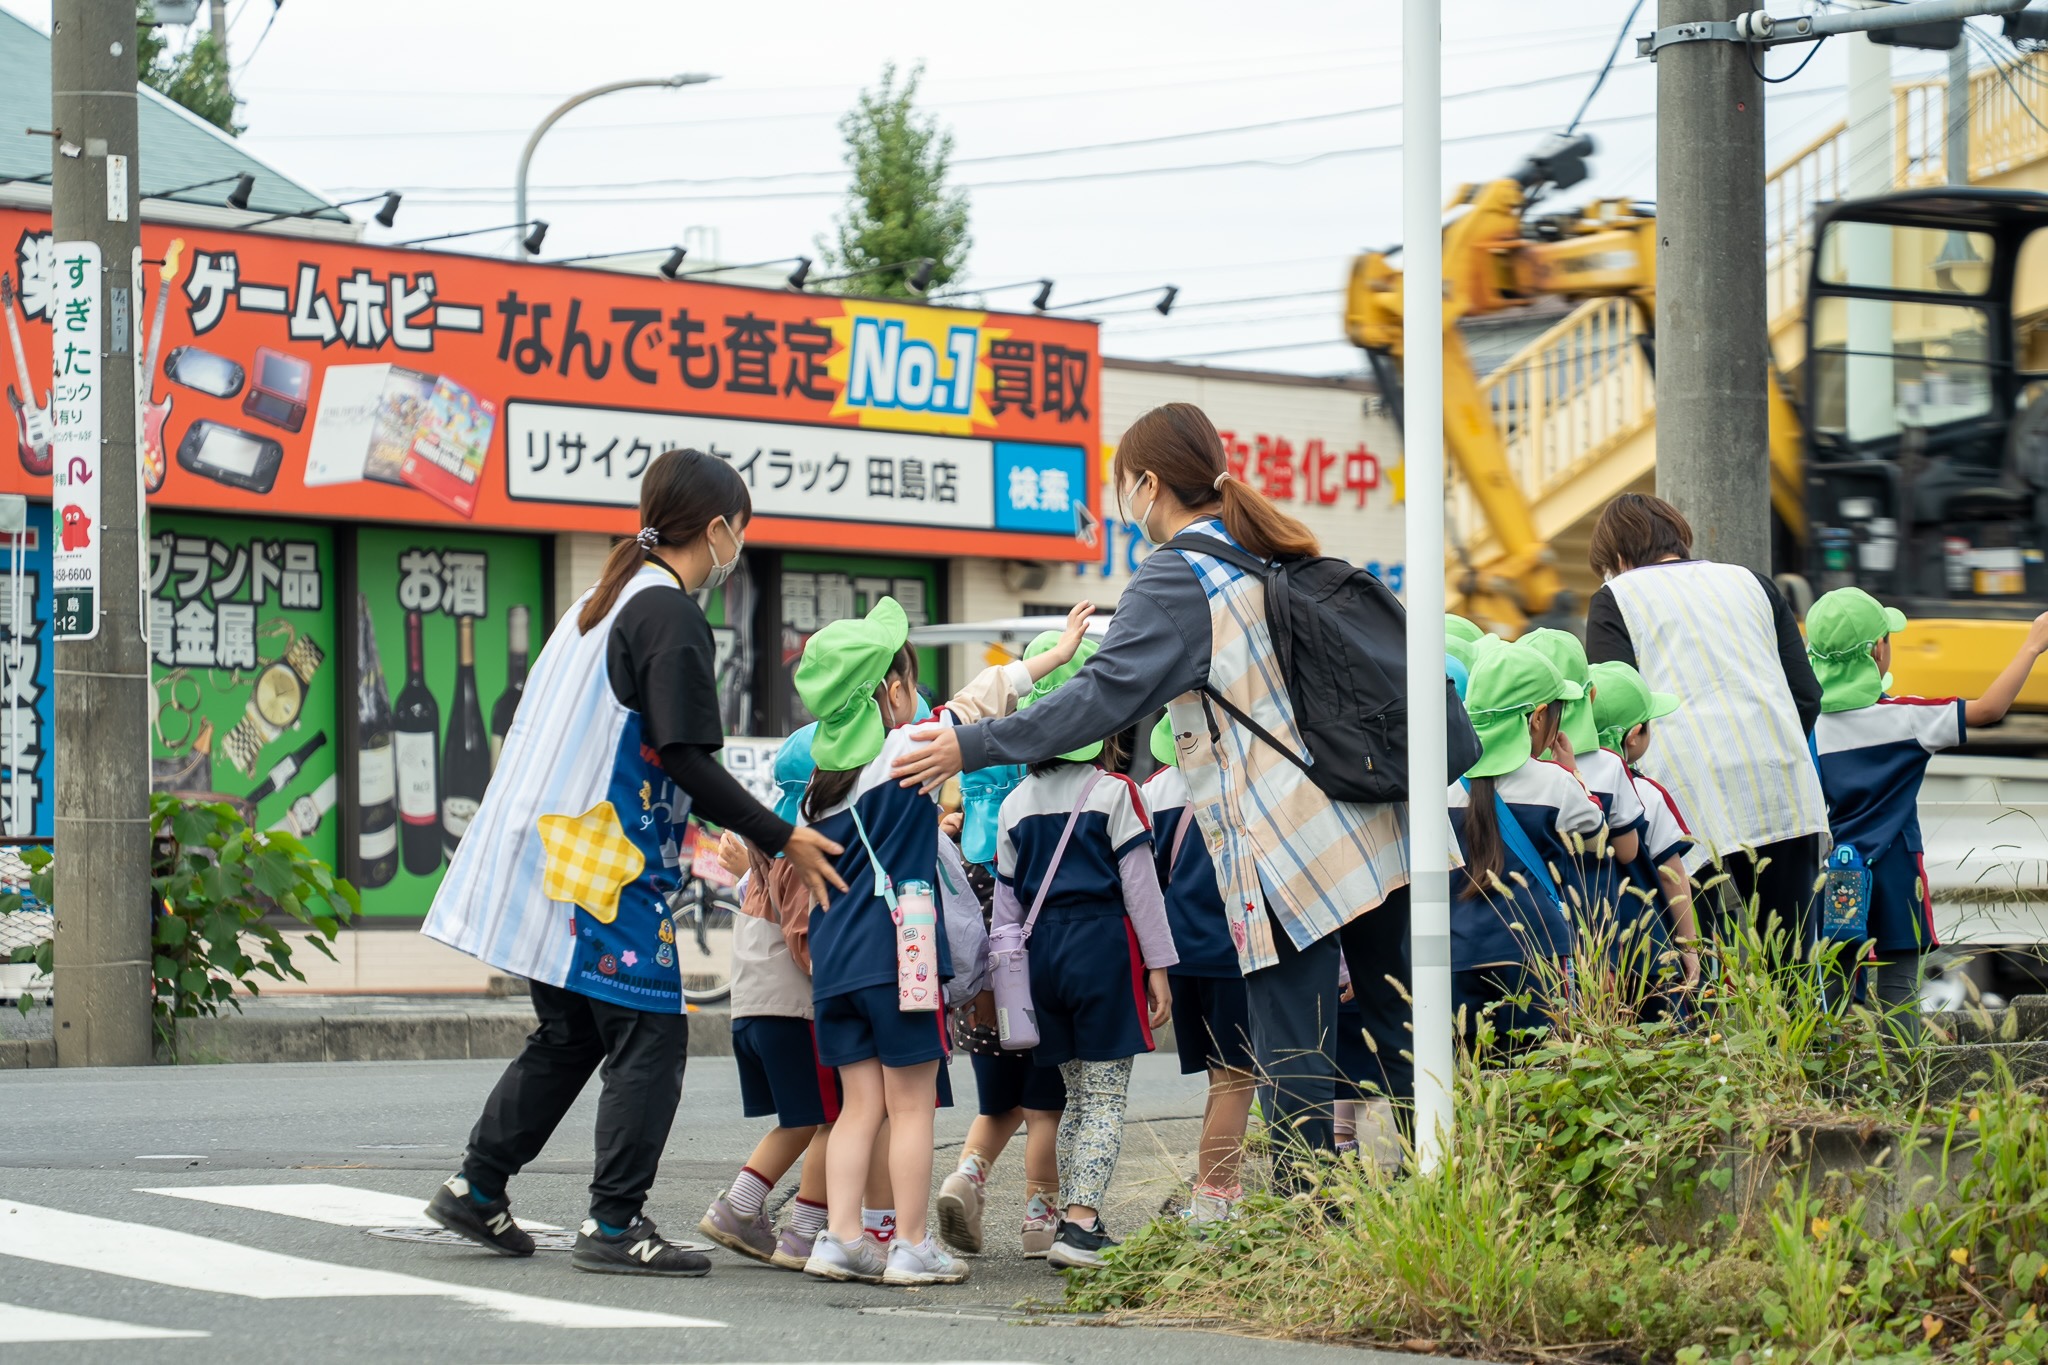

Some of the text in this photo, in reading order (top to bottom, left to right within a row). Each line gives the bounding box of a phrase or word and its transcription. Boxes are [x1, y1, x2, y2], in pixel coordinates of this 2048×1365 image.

[64, 254, 92, 375] すぎた
[184, 251, 482, 349] ゲームホビー
[497, 290, 836, 401] なんでも査定
[847, 315, 979, 415] No.1
[990, 337, 1090, 423] 買取
[526, 430, 677, 479] リサイク
[867, 457, 959, 503] 田島店
[1008, 465, 1071, 512] 検索
[401, 551, 487, 615] お酒
